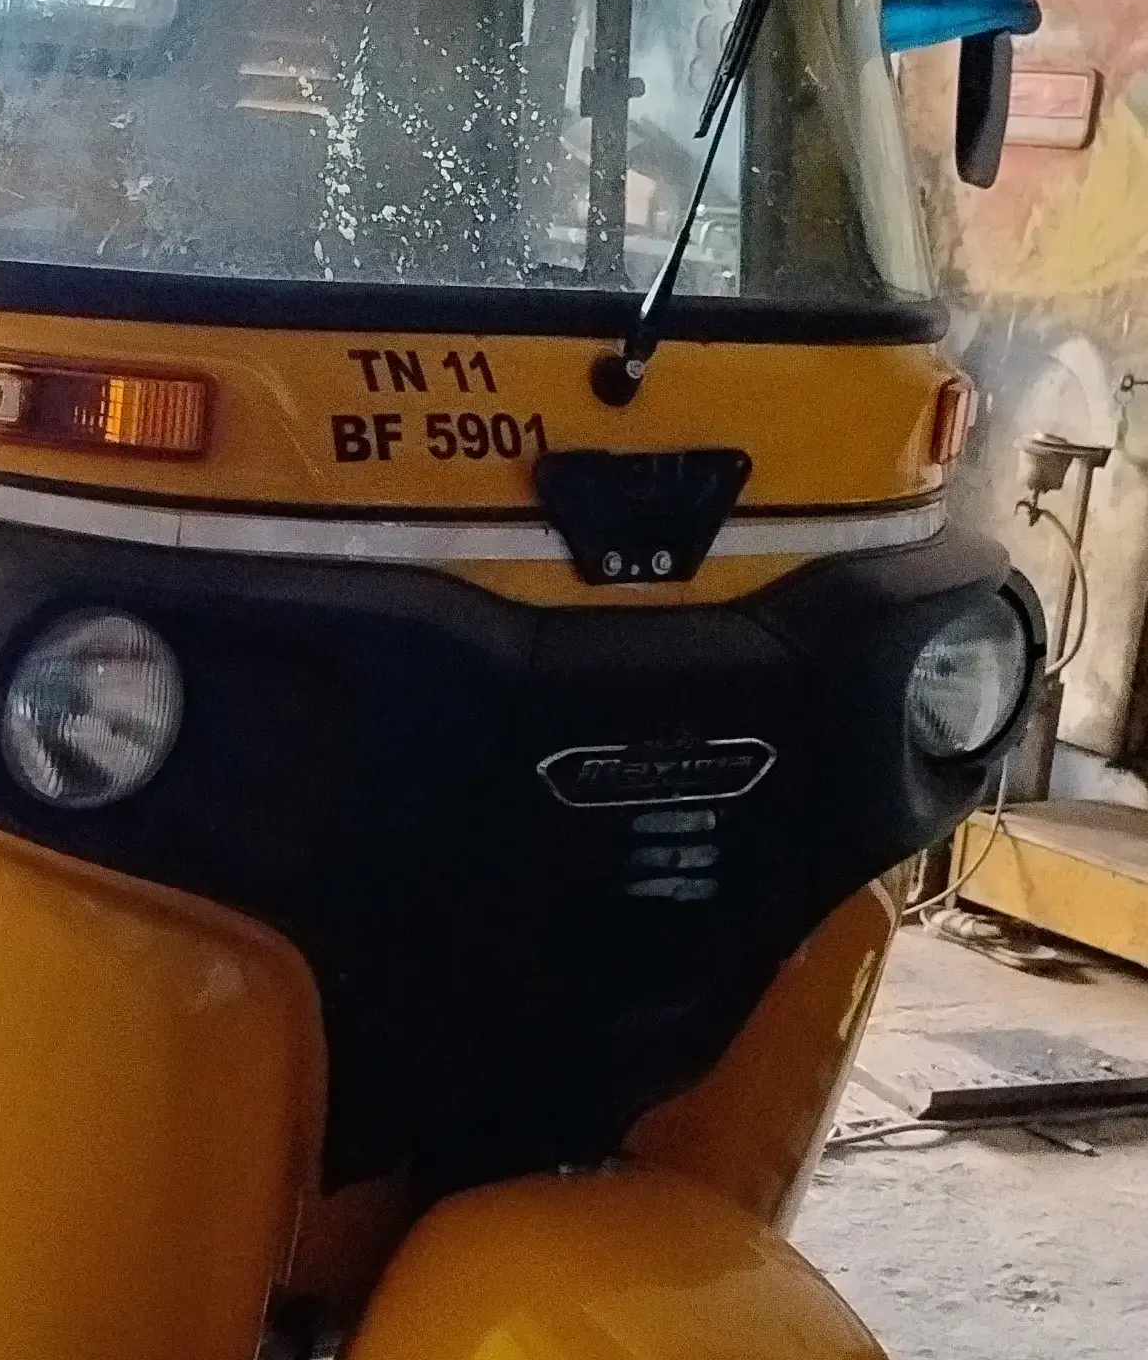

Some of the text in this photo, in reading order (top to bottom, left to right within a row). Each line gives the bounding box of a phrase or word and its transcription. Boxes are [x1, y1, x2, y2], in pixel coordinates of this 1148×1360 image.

[348, 349, 497, 394] TN 11
[331, 411, 548, 463] BF 5901
